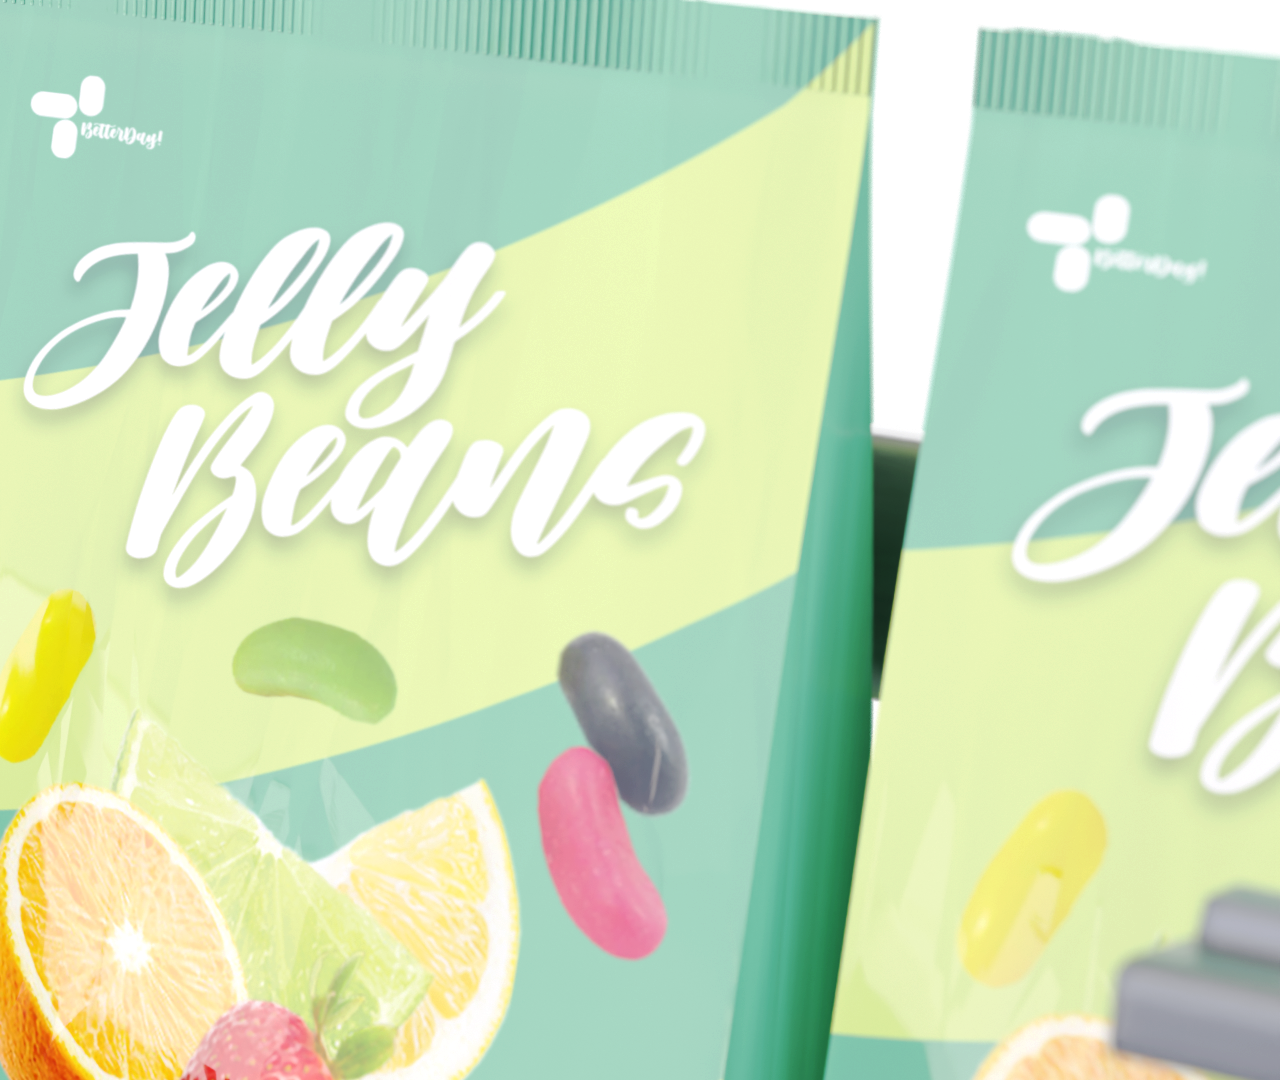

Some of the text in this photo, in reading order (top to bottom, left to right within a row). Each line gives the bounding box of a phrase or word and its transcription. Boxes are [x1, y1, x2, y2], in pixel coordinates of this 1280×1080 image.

[81, 122, 163, 150] BetterDay!
[23, 222, 507, 429] Jelly
[125, 391, 706, 589] Beans
